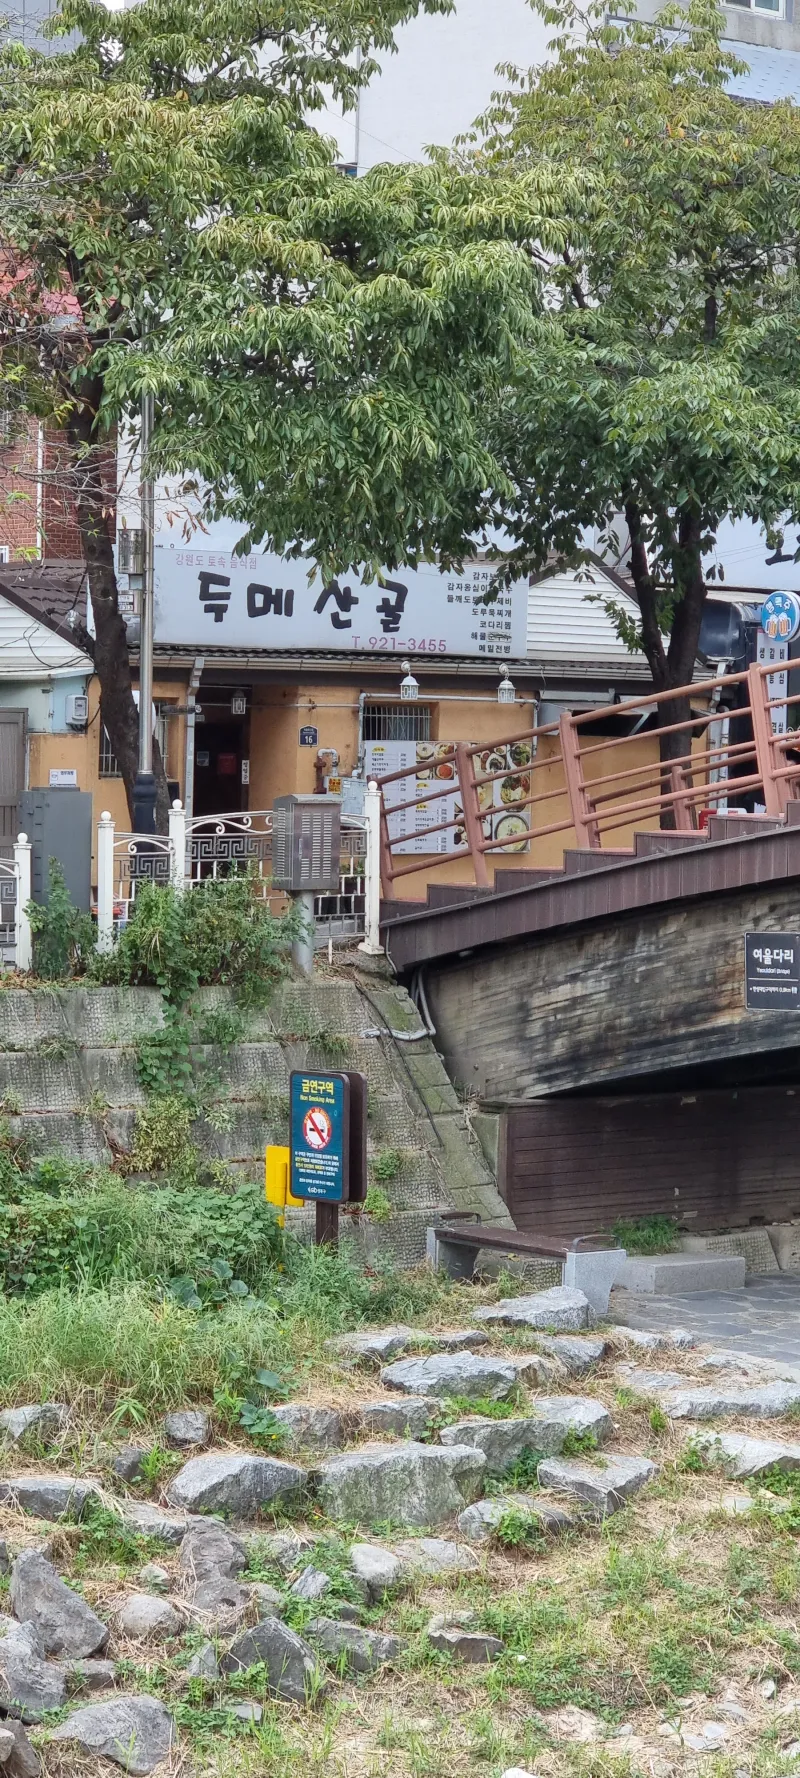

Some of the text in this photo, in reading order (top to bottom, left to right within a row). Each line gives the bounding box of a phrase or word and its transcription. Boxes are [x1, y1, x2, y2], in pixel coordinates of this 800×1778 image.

[176, 554, 257, 570] 강원도 토속 음식점
[305, 735, 313, 744] 16
[753, 948, 794, 965] 여울다리
[302, 1079, 334, 1095] 금연구역
[308, 1095, 325, 1104] Smoking
